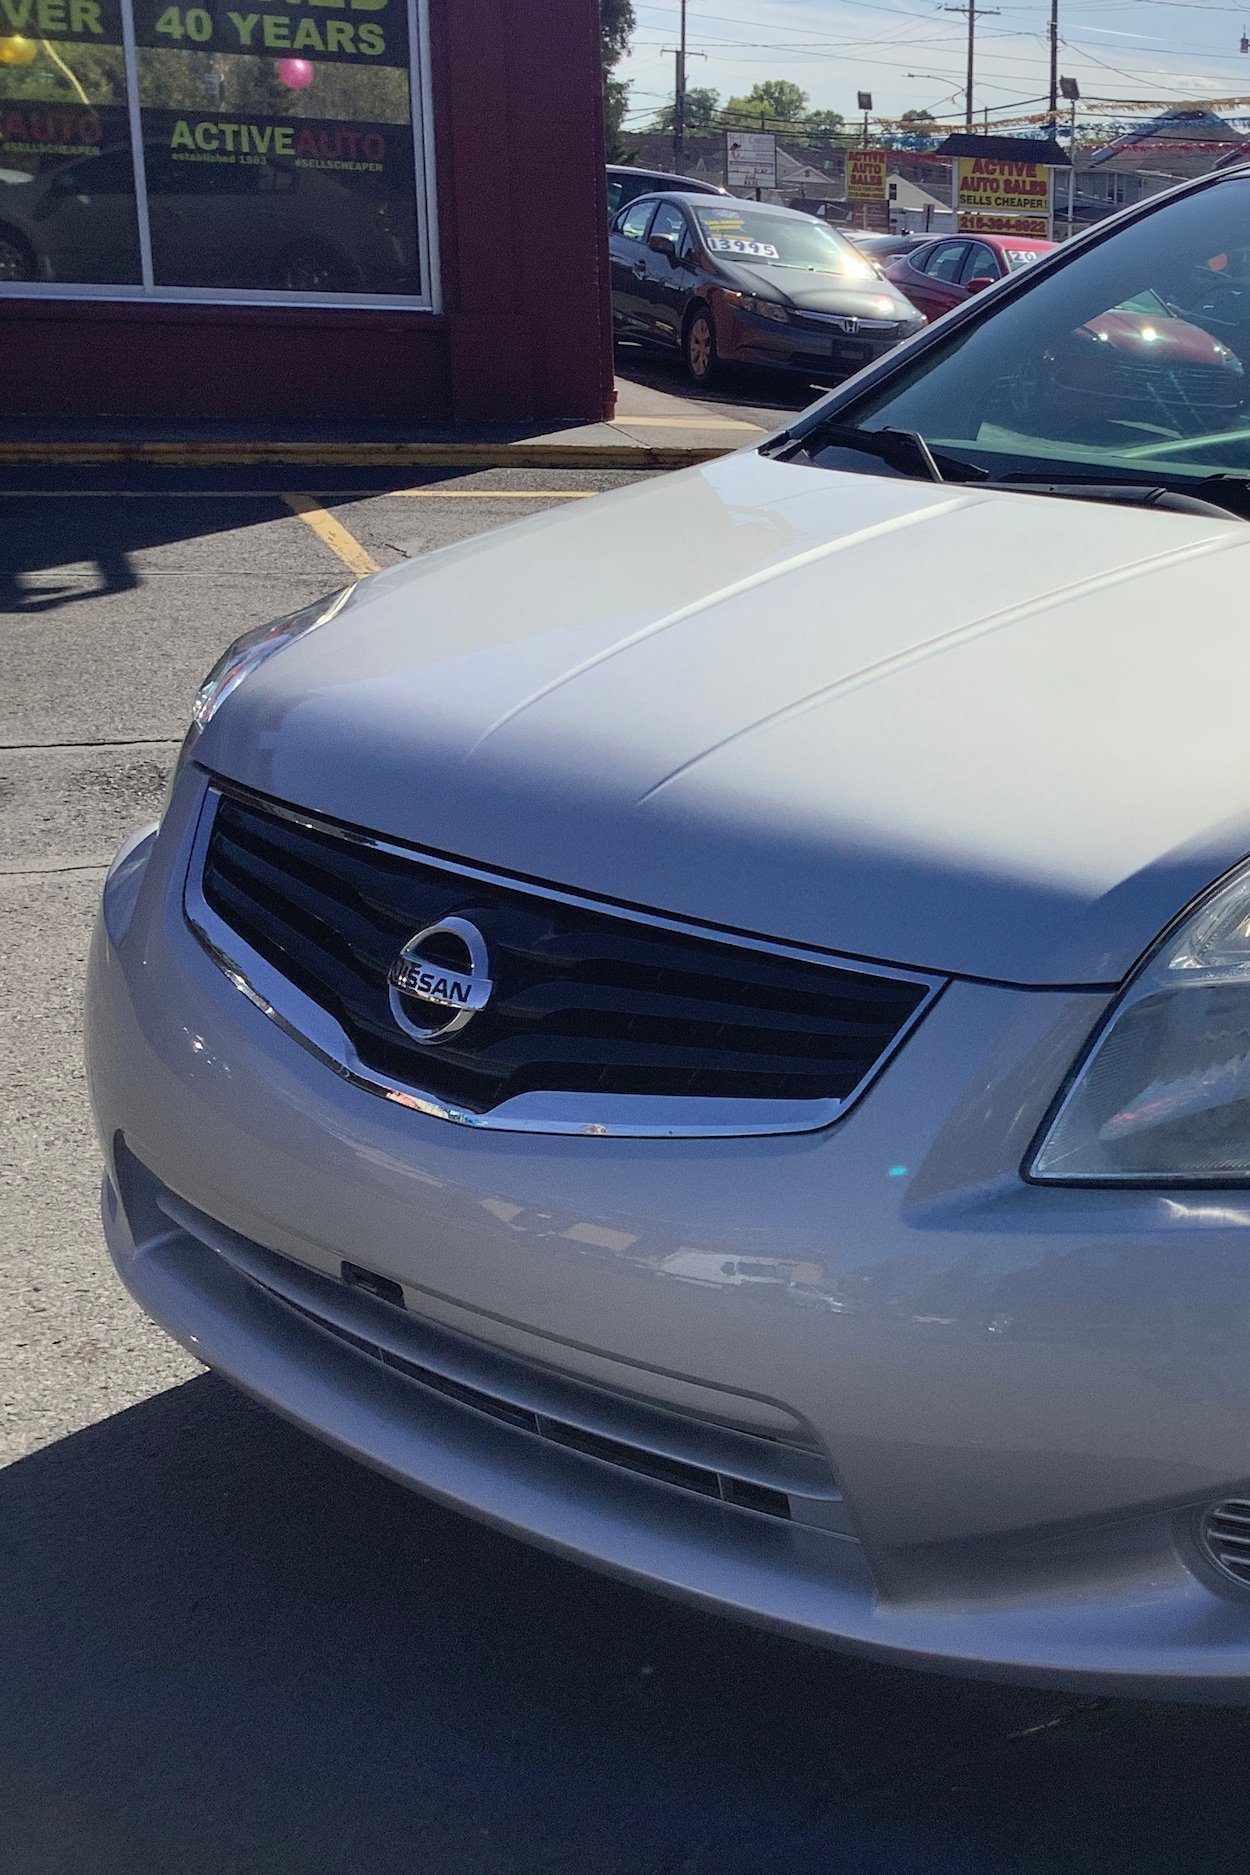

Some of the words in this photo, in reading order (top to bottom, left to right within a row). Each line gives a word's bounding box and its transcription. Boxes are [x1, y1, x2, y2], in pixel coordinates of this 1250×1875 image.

[154, 6, 213, 42] 40
[227, 11, 386, 55] YEARS
[848, 151, 885, 163] ACTIVE
[852, 162, 881, 175] AUTO
[972, 157, 1037, 178] ACTIVE
[850, 174, 882, 187] SALES
[960, 176, 999, 193] AUTO
[1003, 179, 1047, 196] SALES
[959, 194, 993, 205] SELLS
[709, 239, 775, 256] 13995
[1011, 251, 1034, 261] 20
[390, 958, 473, 1003] NISSAN
